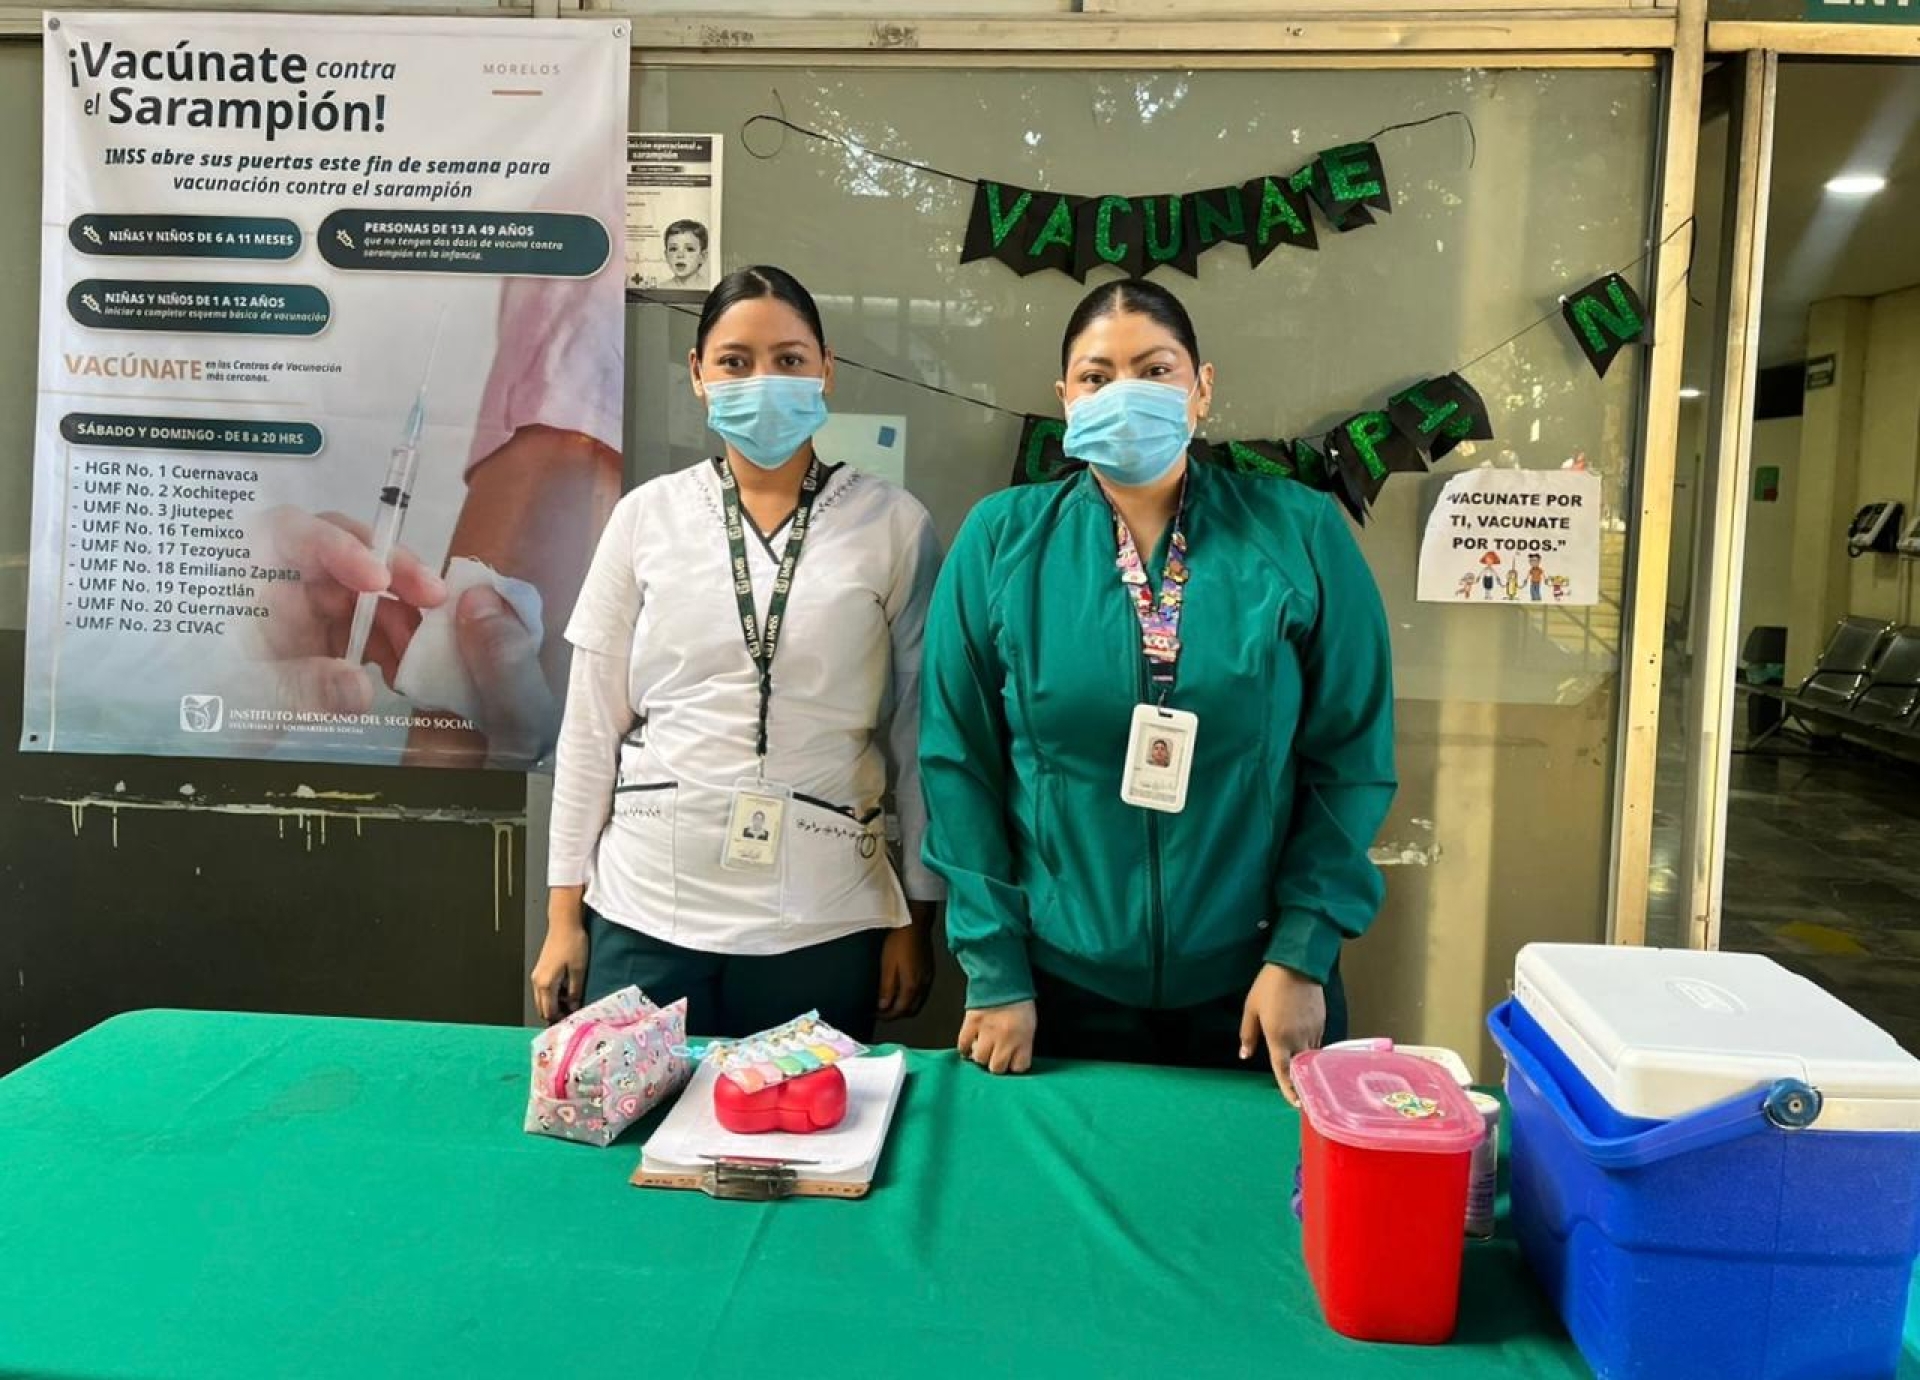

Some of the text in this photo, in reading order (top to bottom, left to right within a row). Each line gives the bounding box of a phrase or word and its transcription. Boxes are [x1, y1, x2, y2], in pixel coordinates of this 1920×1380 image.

[68, 40, 396, 87] ¡Vacúnate contra
[482, 63, 560, 75] MORELOS
[84, 87, 385, 141] el Sarampión!
[105, 148, 550, 178] IMSS abre sus puertas este fin de semana para
[174, 175, 472, 202] vacunación contra el sarampión
[108, 228, 294, 246] NIÑAS Y NIÑOS DE 6 A 11 MESES
[364, 222, 535, 236] PERSONAS DE 13 A 49 AÑOS
[363, 237, 382, 247] que
[104, 291, 285, 309] NIÑAS Y NIÑOS DE 1 A 12 AÑOS
[260, 311, 272, 320] de
[64, 352, 202, 382] VACÚNATE
[205, 361, 216, 370] en
[271, 360, 283, 372] de
[286, 361, 342, 373] Vacunación
[206, 371, 224, 382] más
[77, 422, 135, 437] SÁBADO
[138, 426, 147, 437] Y
[150, 427, 214, 441] DOMINGO
[224, 431, 240, 442] DE
[242, 432, 249, 442] 8
[252, 434, 259, 442] a
[262, 433, 277, 443] 20
[279, 433, 304, 445] HRS
[85, 462, 120, 475] HGR
[125, 463, 153, 478] No.
[160, 465, 166, 478] 1
[172, 465, 259, 482] Cuernavaca
[84, 482, 122, 496] UMF
[125, 483, 154, 497] No.
[158, 485, 168, 498] 2
[172, 484, 255, 503] Xochitepec
[1546, 494, 1582, 507] POR
[83, 500, 121, 515] UMF
[125, 503, 153, 517] No.
[158, 504, 167, 517] 3
[171, 504, 233, 522] Jiutepec
[82, 520, 120, 534] UMF
[125, 522, 151, 536] No.
[158, 523, 176, 536] 16
[180, 524, 244, 540] Temixco
[1450, 514, 1570, 529] TI, VACUNATE
[81, 539, 118, 553] UMF
[124, 540, 151, 555] No.
[158, 542, 175, 555] 17
[180, 543, 250, 560] Tezoyuca
[1452, 536, 1489, 550] POR
[80, 558, 117, 572] UMF
[123, 560, 151, 574] No.
[157, 562, 175, 575] 18
[179, 562, 246, 578] Emiliano
[251, 566, 301, 583] Zapata
[79, 577, 116, 592] UMF
[122, 579, 150, 594] No.
[156, 581, 173, 594] 19
[178, 581, 255, 599] Tepoztlán
[77, 597, 115, 611] UMF
[121, 599, 149, 613] No.
[154, 600, 172, 614] 20
[178, 600, 269, 617] Cuernavaca
[76, 616, 114, 630] UMF
[120, 618, 148, 632] No.
[153, 620, 172, 633] 23
[176, 621, 225, 635] CIVAC
[229, 708, 476, 730] INSTITUTO MEXICANO DEL SEGURO SOCIAL
